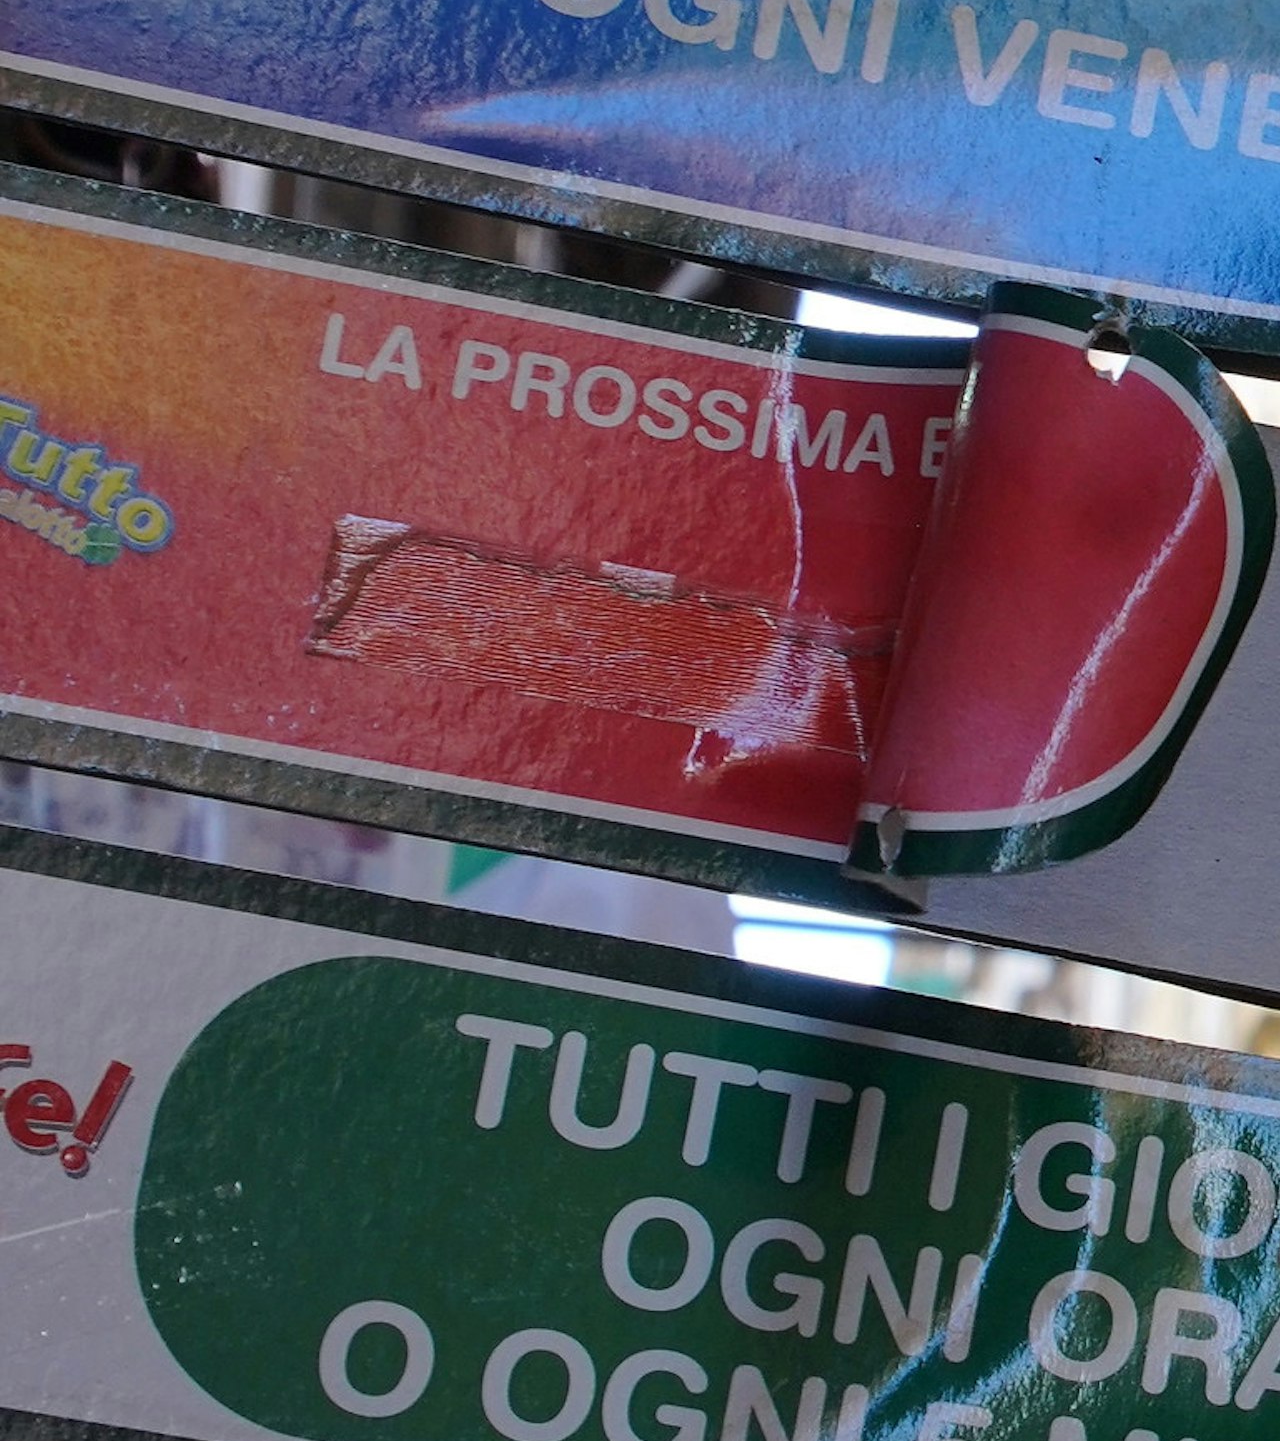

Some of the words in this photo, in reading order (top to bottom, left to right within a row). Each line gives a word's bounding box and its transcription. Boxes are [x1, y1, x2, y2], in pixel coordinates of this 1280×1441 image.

[318, 313, 422, 390] LA
[451, 340, 895, 477] PROSSIMA
[453, 1012, 880, 1191] TUTTI
[927, 1103, 966, 1211] I
[317, 1299, 433, 1419] O
[601, 1194, 984, 1364] OGNI
